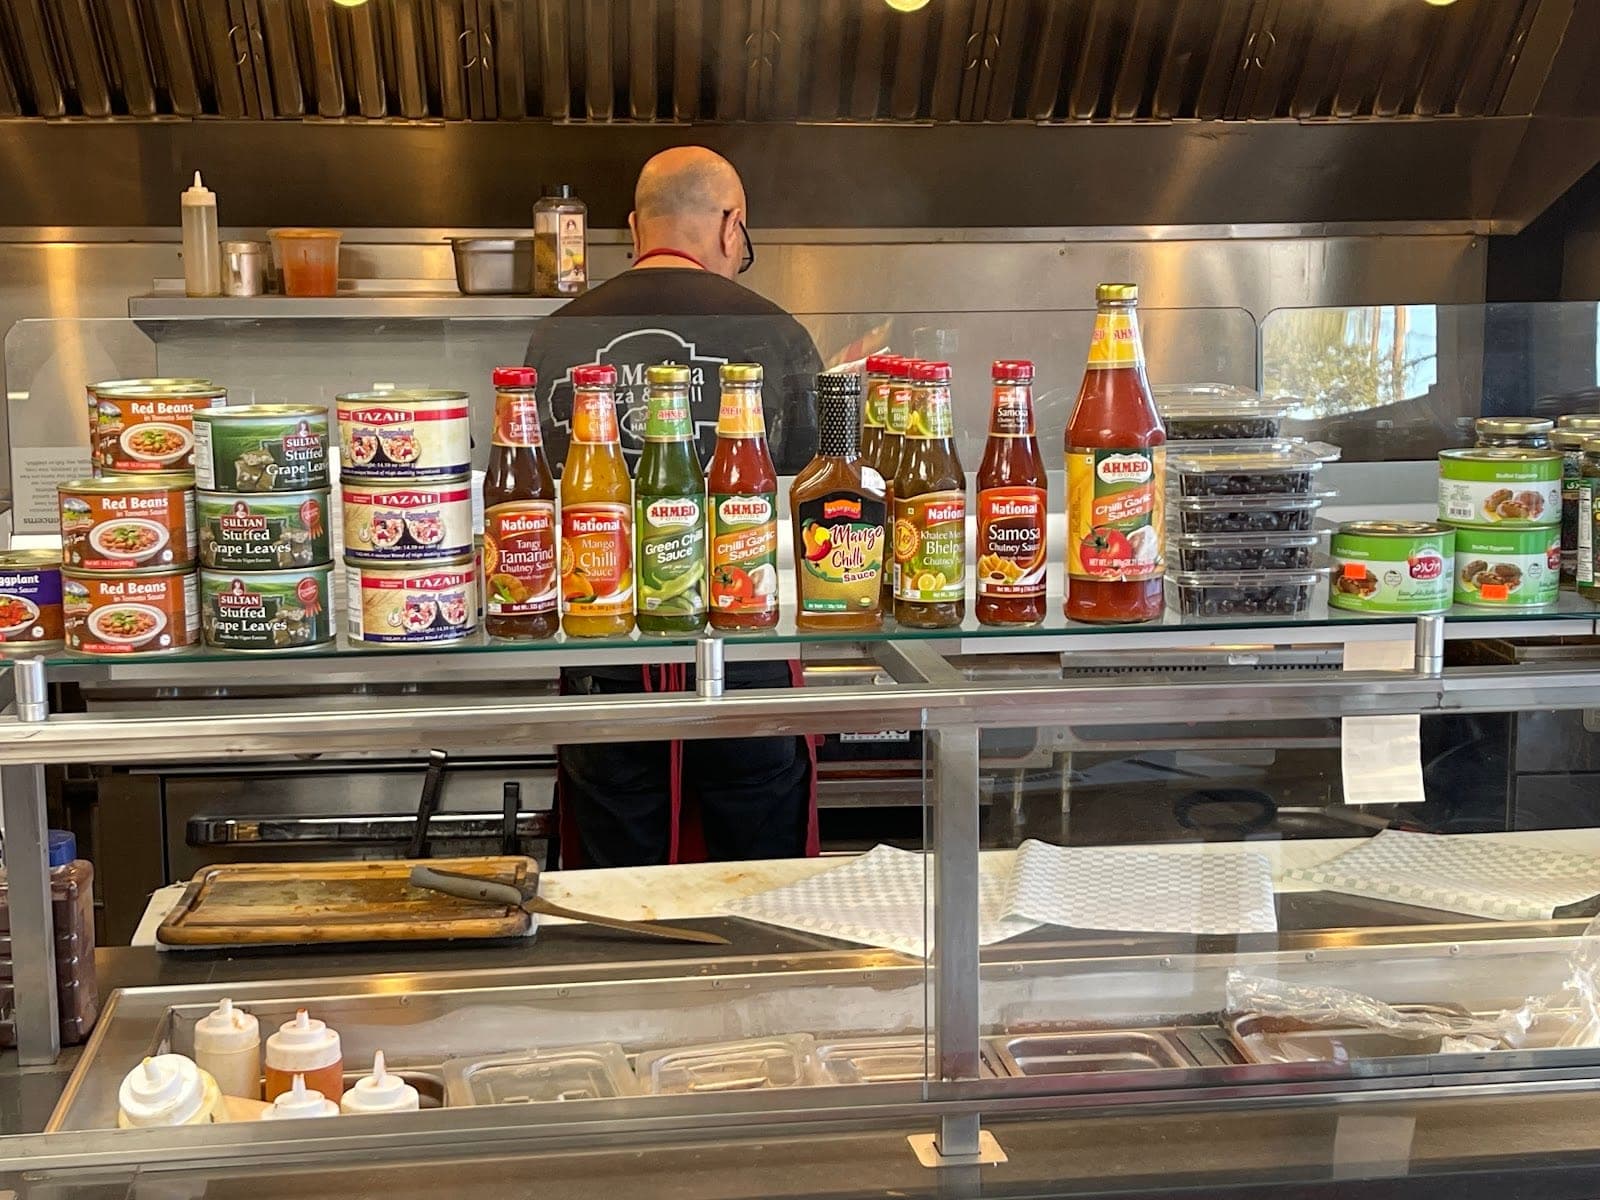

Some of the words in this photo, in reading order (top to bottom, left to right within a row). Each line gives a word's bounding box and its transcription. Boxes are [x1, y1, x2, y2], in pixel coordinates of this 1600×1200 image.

[131, 402, 154, 414] Red
[157, 402, 194, 414] Beans
[356, 411, 406, 422] TAZAH
[286, 437, 320, 447] SULTAN
[285, 447, 323, 462] Stuffed
[265, 463, 305, 477] Grape
[1102, 461, 1148, 473] AHMED
[102, 497, 127, 510] Red
[130, 496, 168, 509] Beans
[723, 502, 768, 515] AHMED
[991, 502, 1037, 515] National
[1095, 501, 1122, 515] Chilli
[1124, 493, 1152, 506] Garlic
[651, 504, 696, 518] AHMED
[1107, 505, 1143, 521] Sauce
[23, 517, 60, 525] oncerns
[223, 518, 263, 528] SULTAN
[501, 517, 549, 531] National
[573, 517, 620, 531] National
[222, 528, 270, 541] Stuffed
[829, 523, 884, 551] Mango
[989, 524, 1040, 540] Samosa
[209, 541, 241, 557] Grape
[246, 542, 291, 554] Leaves
[516, 540, 541, 551] Tangy
[582, 539, 615, 551] Mango
[645, 538, 680, 556] Green
[717, 540, 745, 555] Chilli
[746, 530, 776, 547] Garlic
[989, 542, 1020, 554] Chutney
[500, 544, 554, 564] Tamarind
[657, 545, 693, 564] Sauce
[729, 543, 767, 561] Sauce
[831, 546, 865, 568] Chilli
[580, 552, 617, 567] Chilli
[500, 563, 534, 576] Chutney
[536, 561, 554, 571] Sauce
[586, 568, 612, 577] Sauce
[0, 574, 39, 588] ggplant
[843, 569, 876, 584] Sauce
[100, 582, 124, 595] Red
[128, 582, 166, 595] Beans
[220, 595, 259, 605] SULTAN
[220, 606, 266, 618] Stuffed
[242, 620, 288, 631] Leaves
